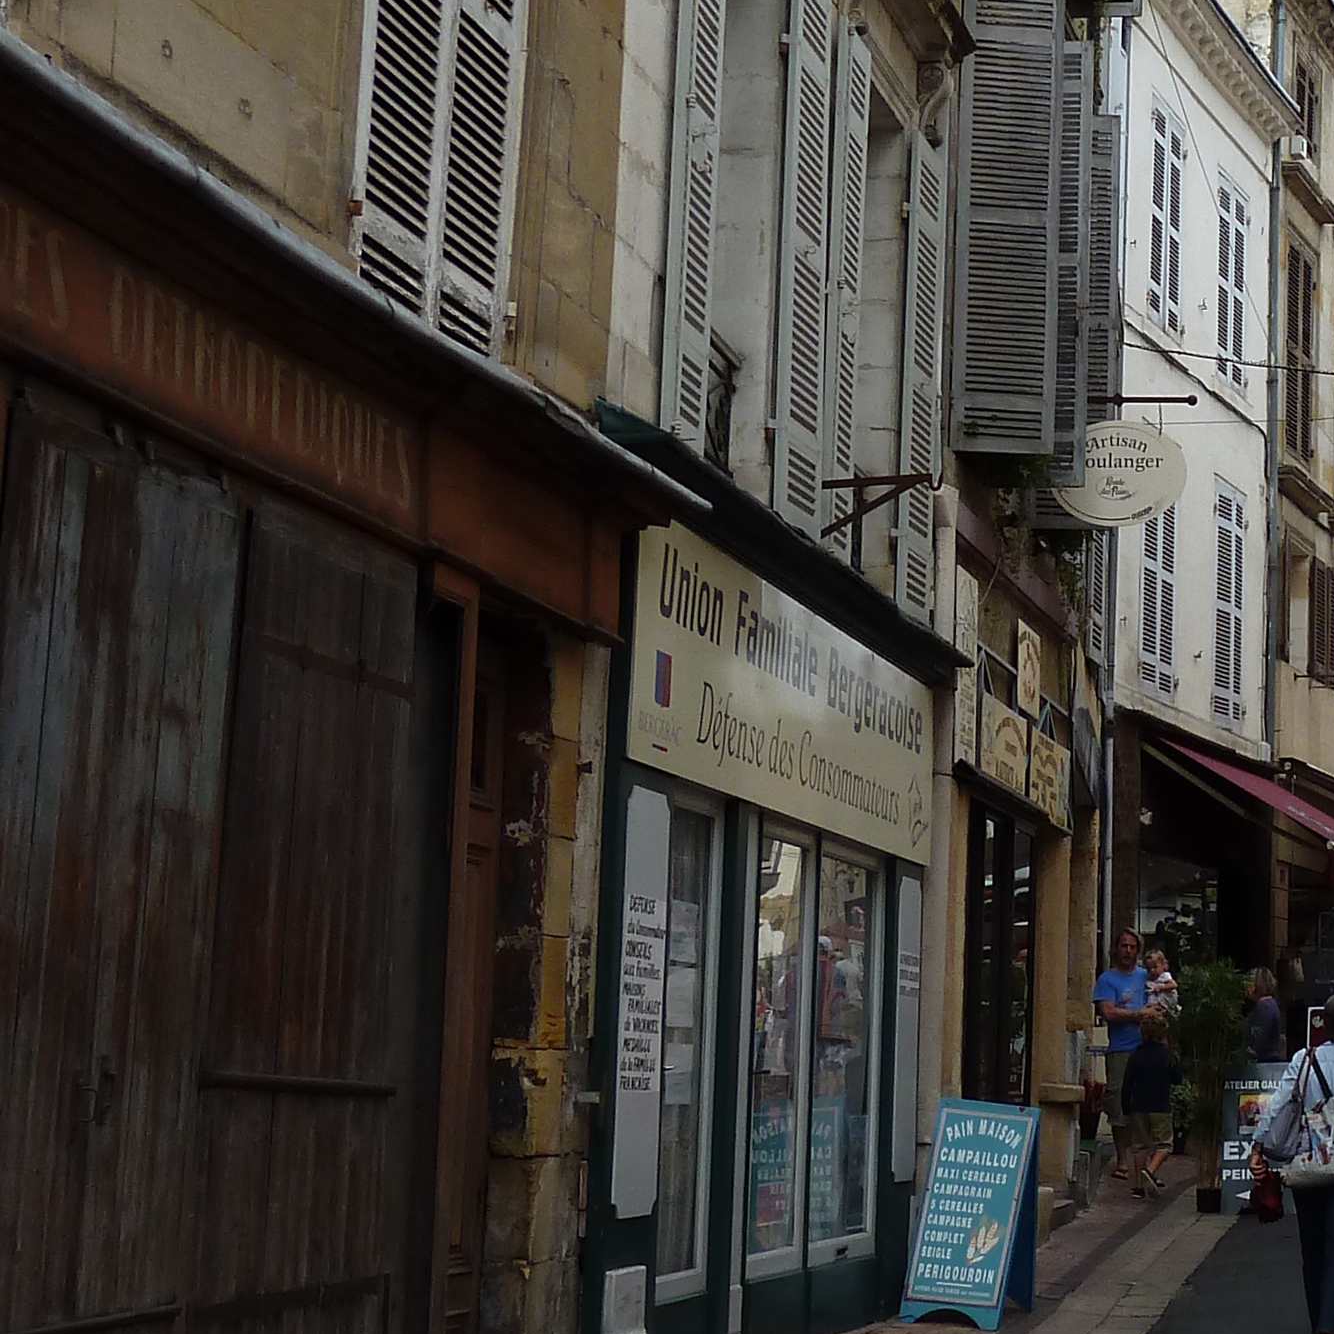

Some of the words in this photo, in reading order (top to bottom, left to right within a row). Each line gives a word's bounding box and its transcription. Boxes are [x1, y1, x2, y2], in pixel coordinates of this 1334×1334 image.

[1086, 432, 1148, 454] Artisan
[1084, 452, 1164, 473] oulanger
[660, 542, 724, 646] Union
[734, 589, 818, 697] Familiale
[827, 646, 923, 755] Bergeracoise
[696, 680, 763, 767] Défense
[769, 718, 795, 781] des
[799, 730, 900, 826] Consommateurs
[1223, 1080, 1259, 1090] ATELIER
[946, 1119, 974, 1142] PAIN
[978, 1118, 1023, 1150] MAISON
[940, 1146, 1018, 1169] CAMPAILLOU
[936, 1166, 960, 1180] MAXI
[962, 1170, 1008, 1185] CEREALES
[933, 1182, 993, 1200] CAMPAGRAIN
[930, 1199, 936, 1210] 5
[939, 1200, 985, 1215] CEREALES
[927, 1213, 973, 1229] CAMPAGNE
[924, 1229, 965, 1245] COMPLET
[921, 1244, 953, 1260] SEIGLE
[916, 1262, 995, 1285] PERIGOURDIN
